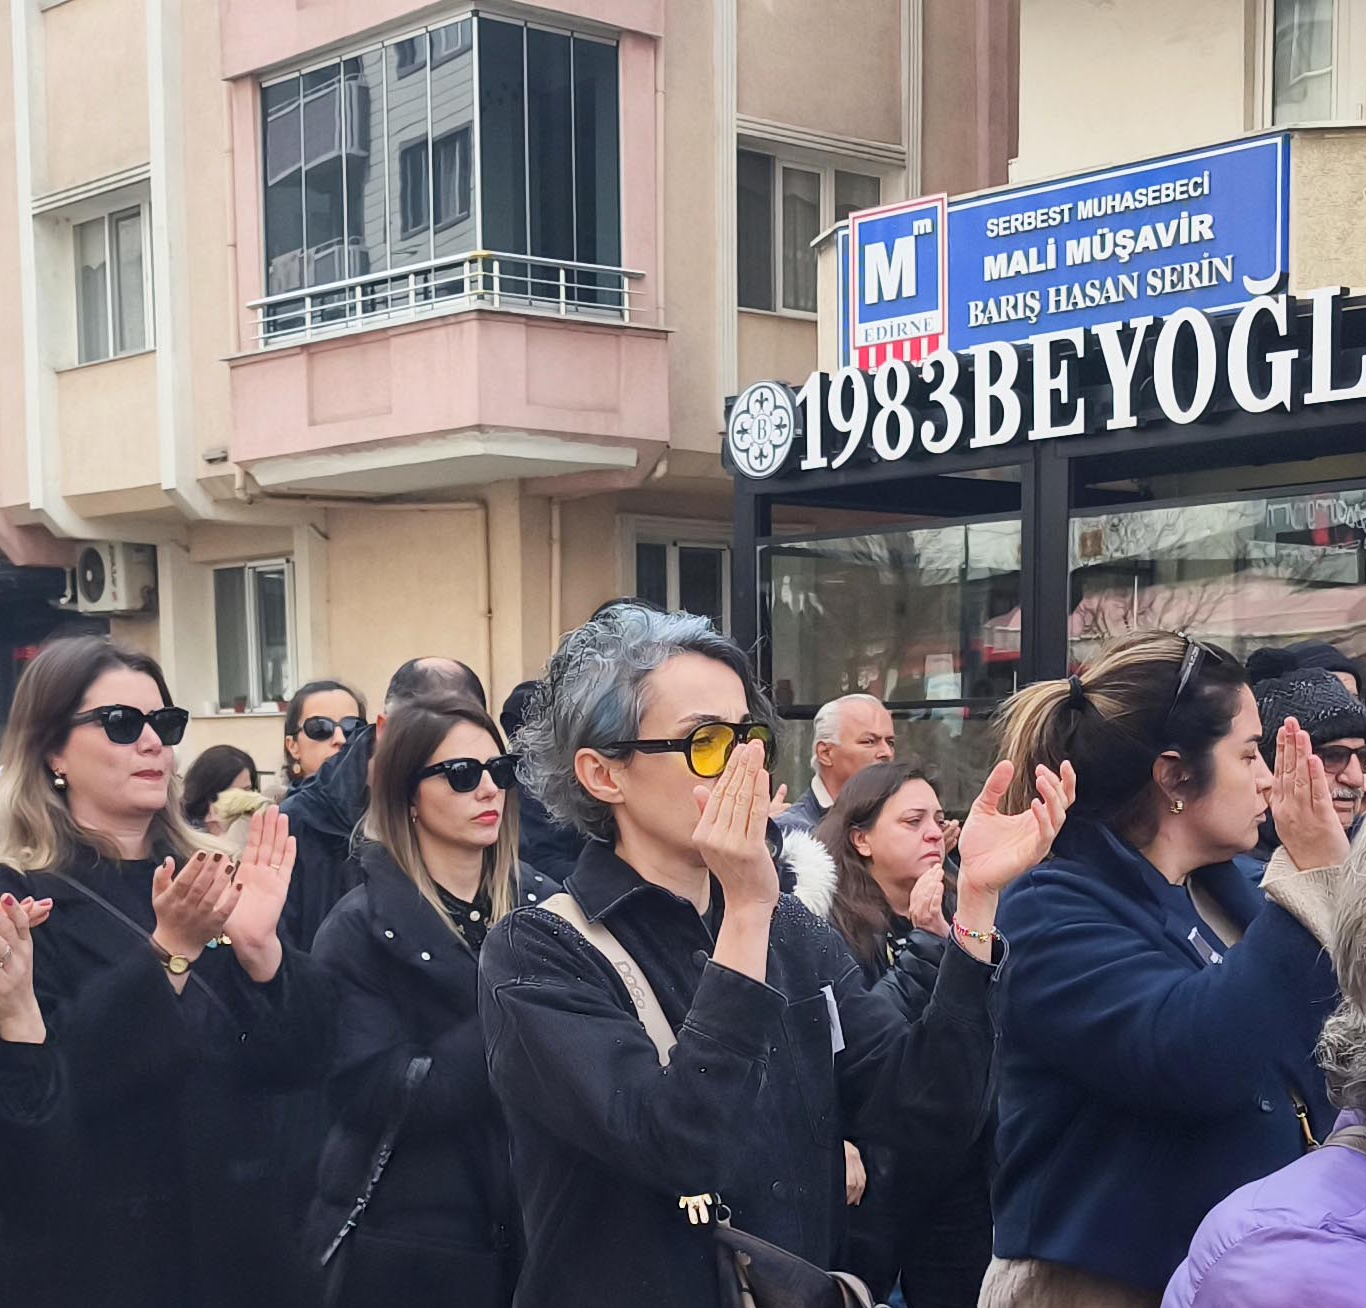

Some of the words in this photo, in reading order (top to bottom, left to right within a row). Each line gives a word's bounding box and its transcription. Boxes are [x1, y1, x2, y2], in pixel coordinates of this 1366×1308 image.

[986, 203, 1072, 237] SERBEST
[1077, 170, 1210, 220] MUHASEBECİ
[983, 238, 1057, 281] MALİ
[1066, 211, 1215, 263] MÜŞAVİR
[967, 291, 1040, 328] BARIŞ
[1047, 272, 1139, 314] HASAN
[1146, 253, 1234, 296] SERİN
[864, 317, 934, 343] EDİRNE
